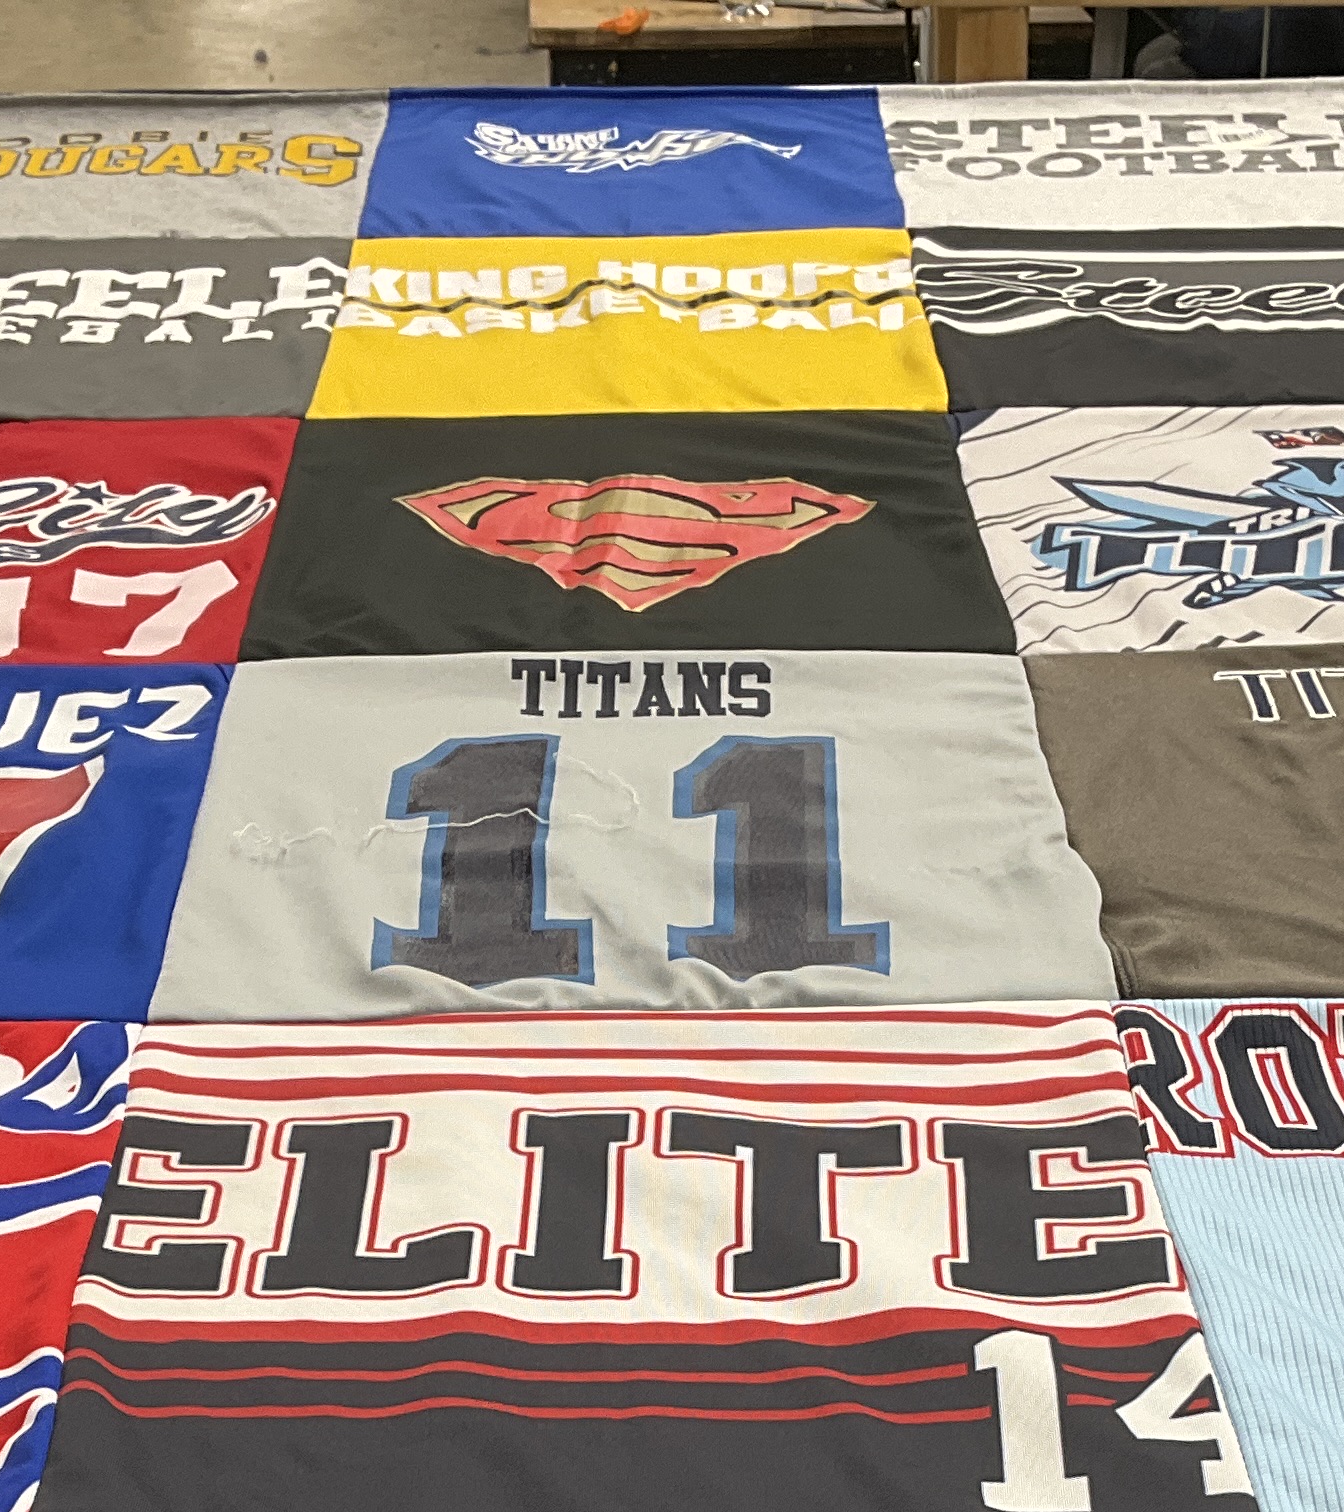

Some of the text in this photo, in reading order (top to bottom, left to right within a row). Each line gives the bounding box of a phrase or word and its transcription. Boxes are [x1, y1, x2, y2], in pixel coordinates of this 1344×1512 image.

[343, 264, 567, 304] KING
[511, 657, 774, 720] TITANS
[369, 732, 892, 988] 11
[80, 1105, 1186, 1305] ELITE
